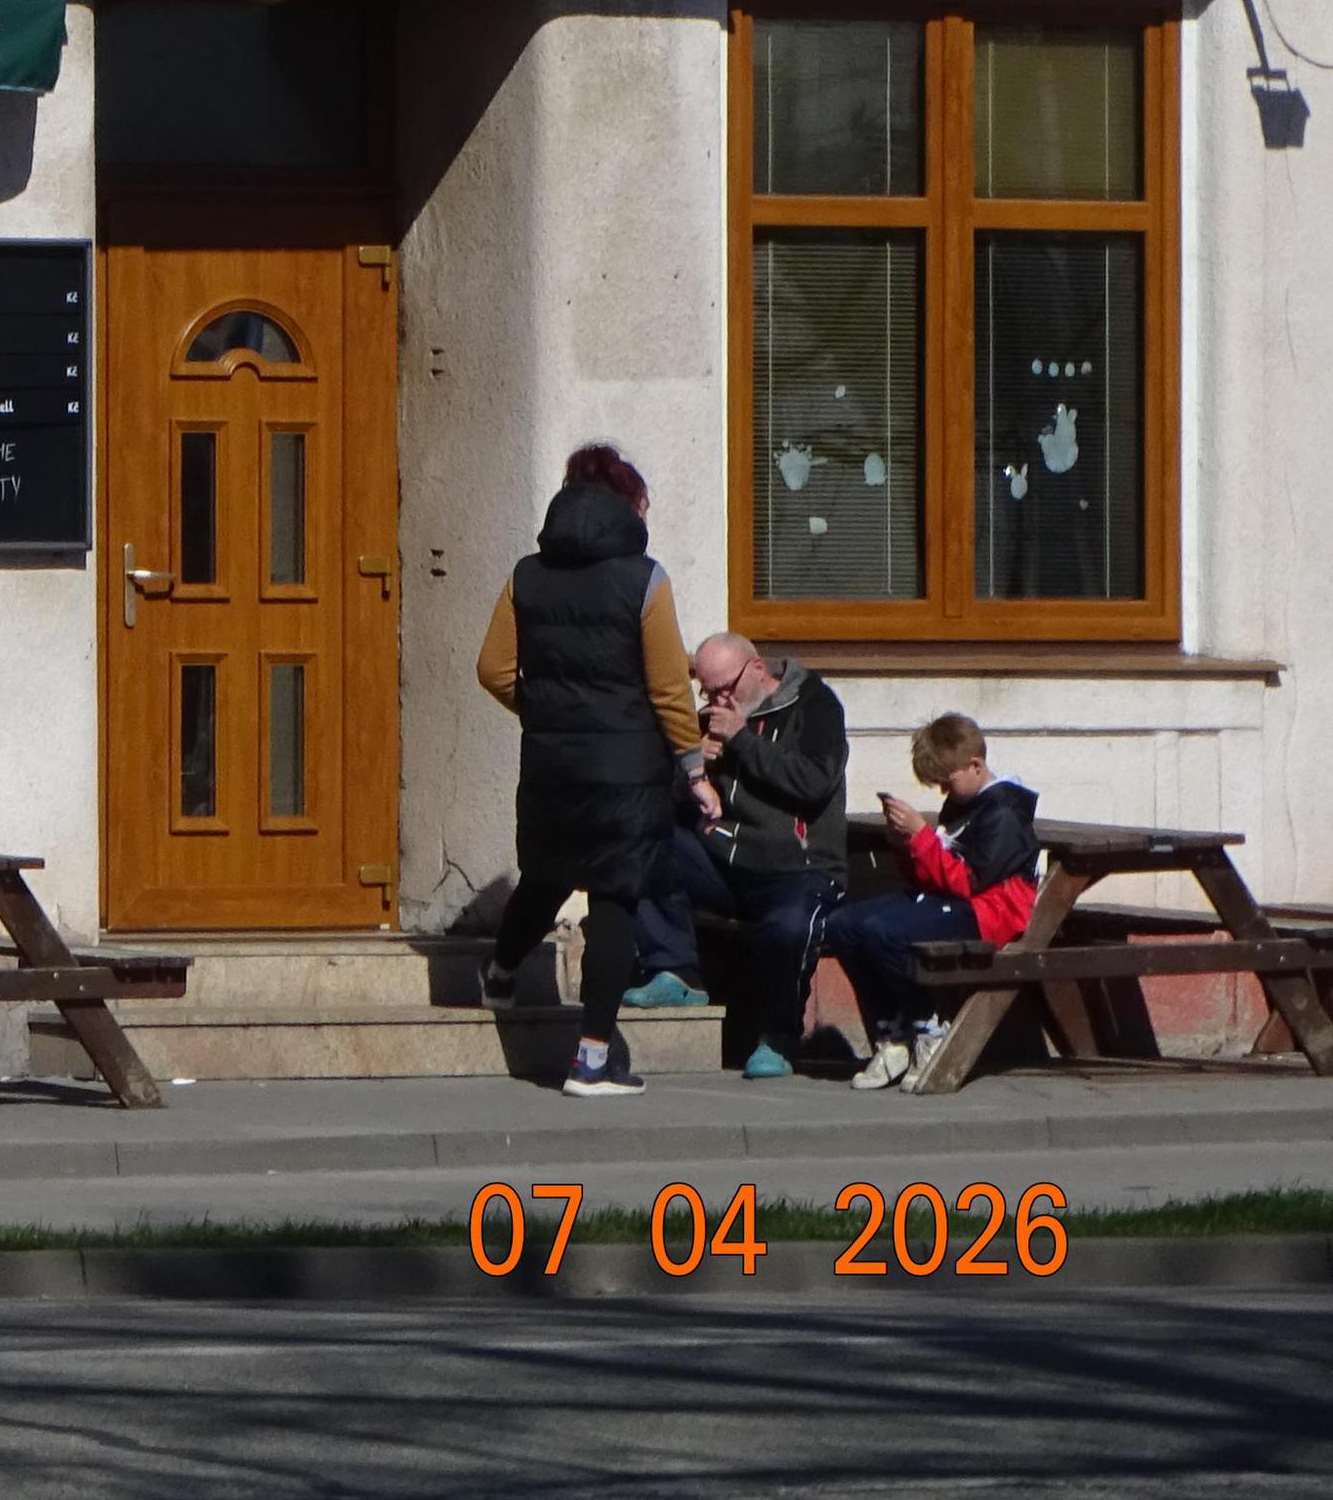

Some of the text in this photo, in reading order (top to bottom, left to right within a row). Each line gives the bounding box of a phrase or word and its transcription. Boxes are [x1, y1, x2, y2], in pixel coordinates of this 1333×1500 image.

[66, 291, 79, 303] Kč
[67, 332, 79, 344] Kč
[66, 365, 79, 377] Kč
[67, 401, 80, 414] Kč
